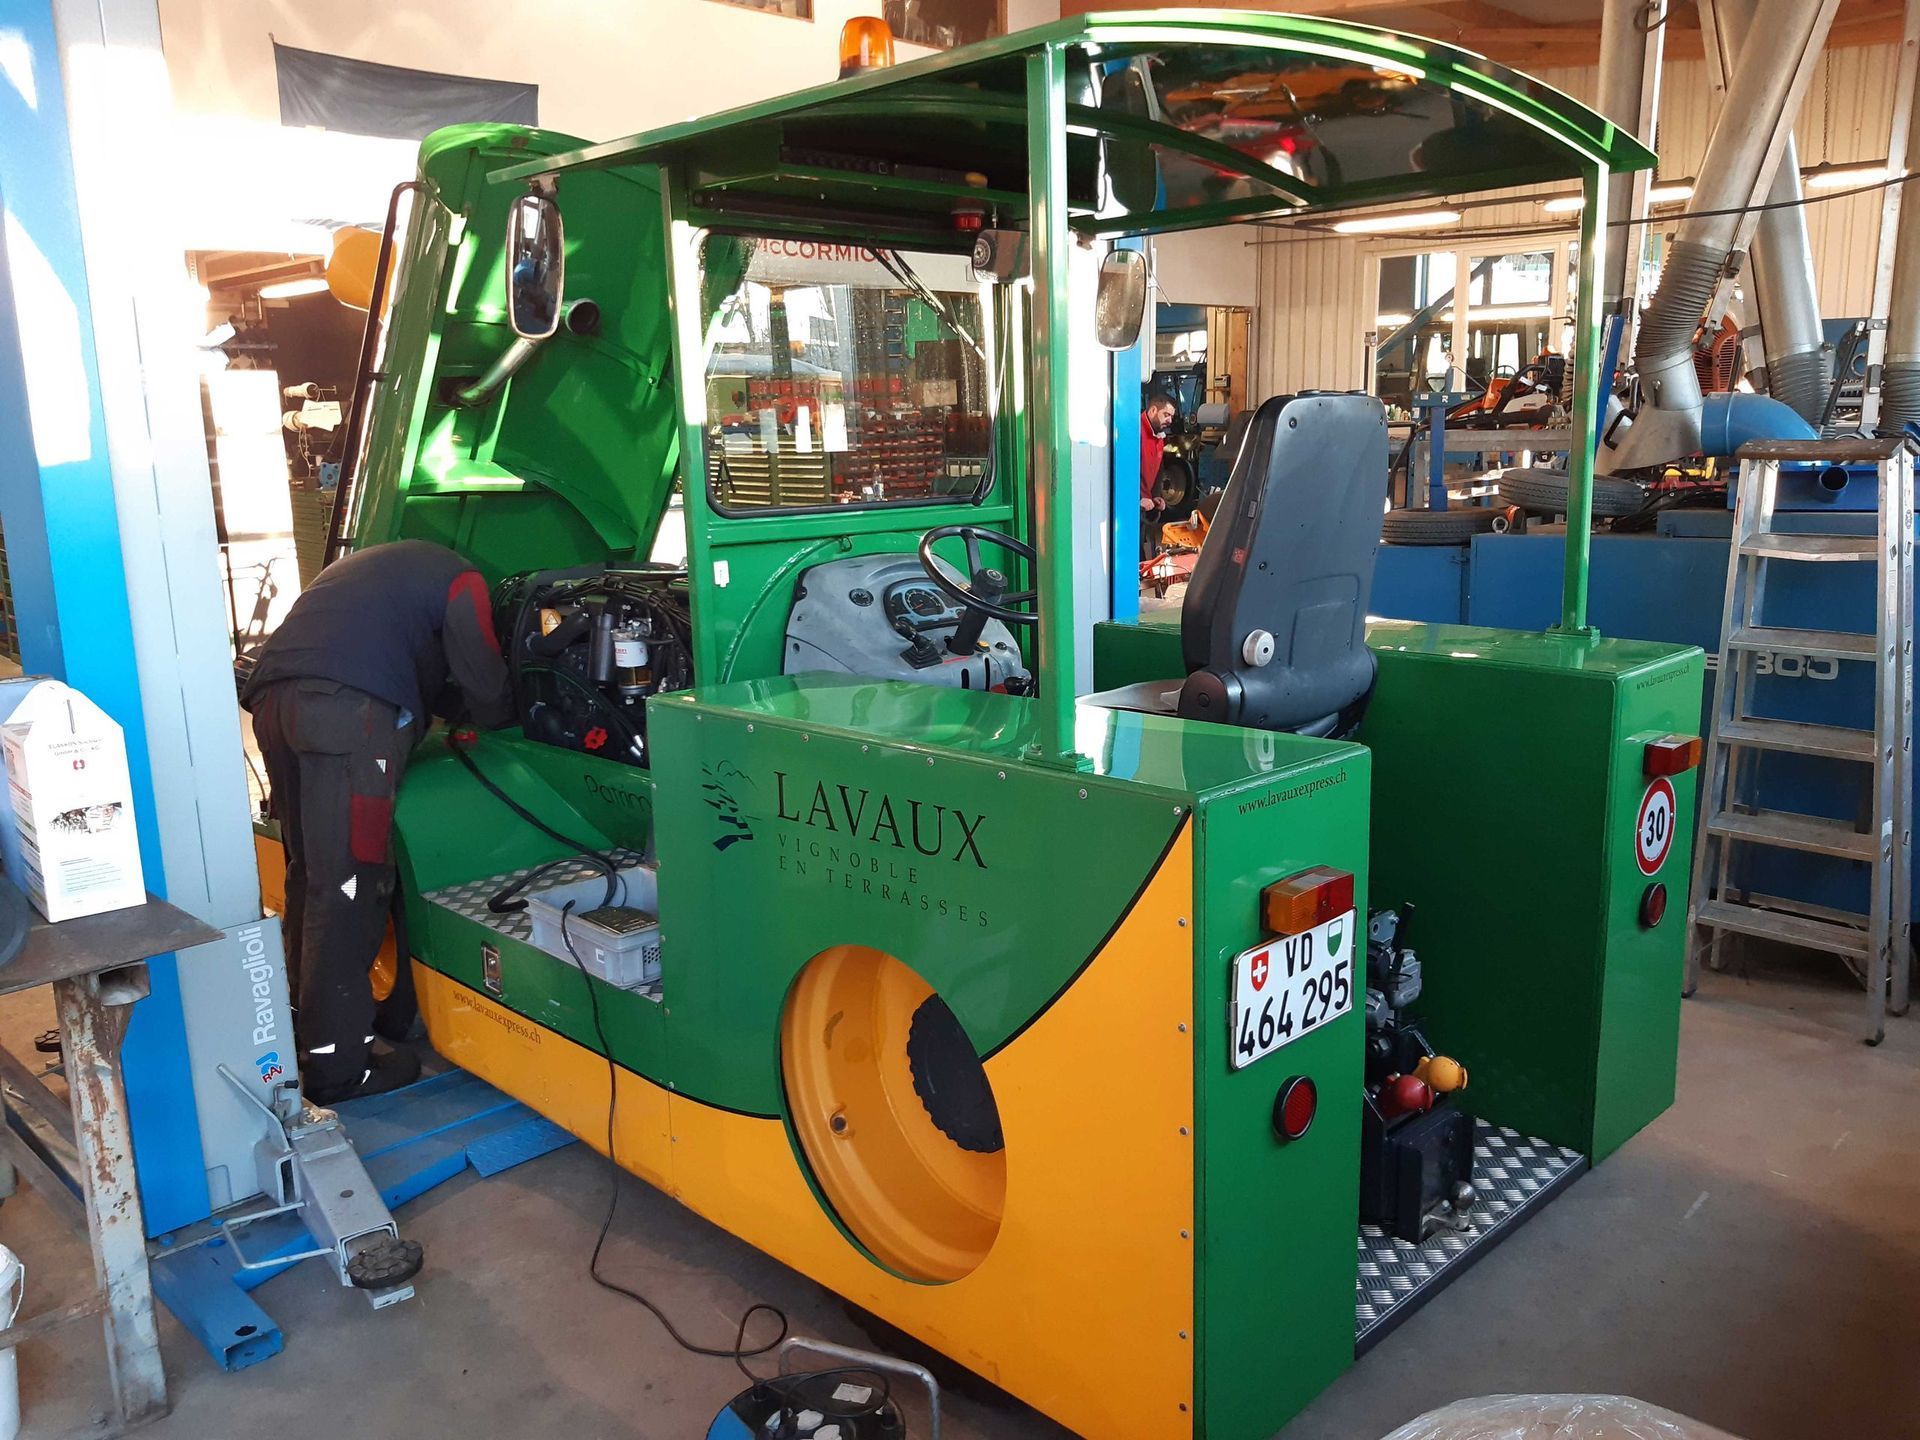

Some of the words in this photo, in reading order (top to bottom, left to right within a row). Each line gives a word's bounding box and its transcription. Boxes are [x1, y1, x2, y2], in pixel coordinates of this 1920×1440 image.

[1238, 767, 1347, 815] www.lavauxexpress.ch
[773, 771, 988, 869] LAVAUX
[1645, 806, 1666, 848] 30
[778, 833, 918, 884] VIGNOBLE
[779, 855, 807, 875] EN
[826, 868, 988, 927] TERRASSES
[1285, 931, 1313, 978] VD
[238, 925, 277, 1046] Ravaglioli
[1238, 988, 1294, 1057] 464
[1302, 959, 1349, 1030] 295
[453, 990, 542, 1045] www.lavauxexpress.ch
[262, 1064, 284, 1084] RAV
